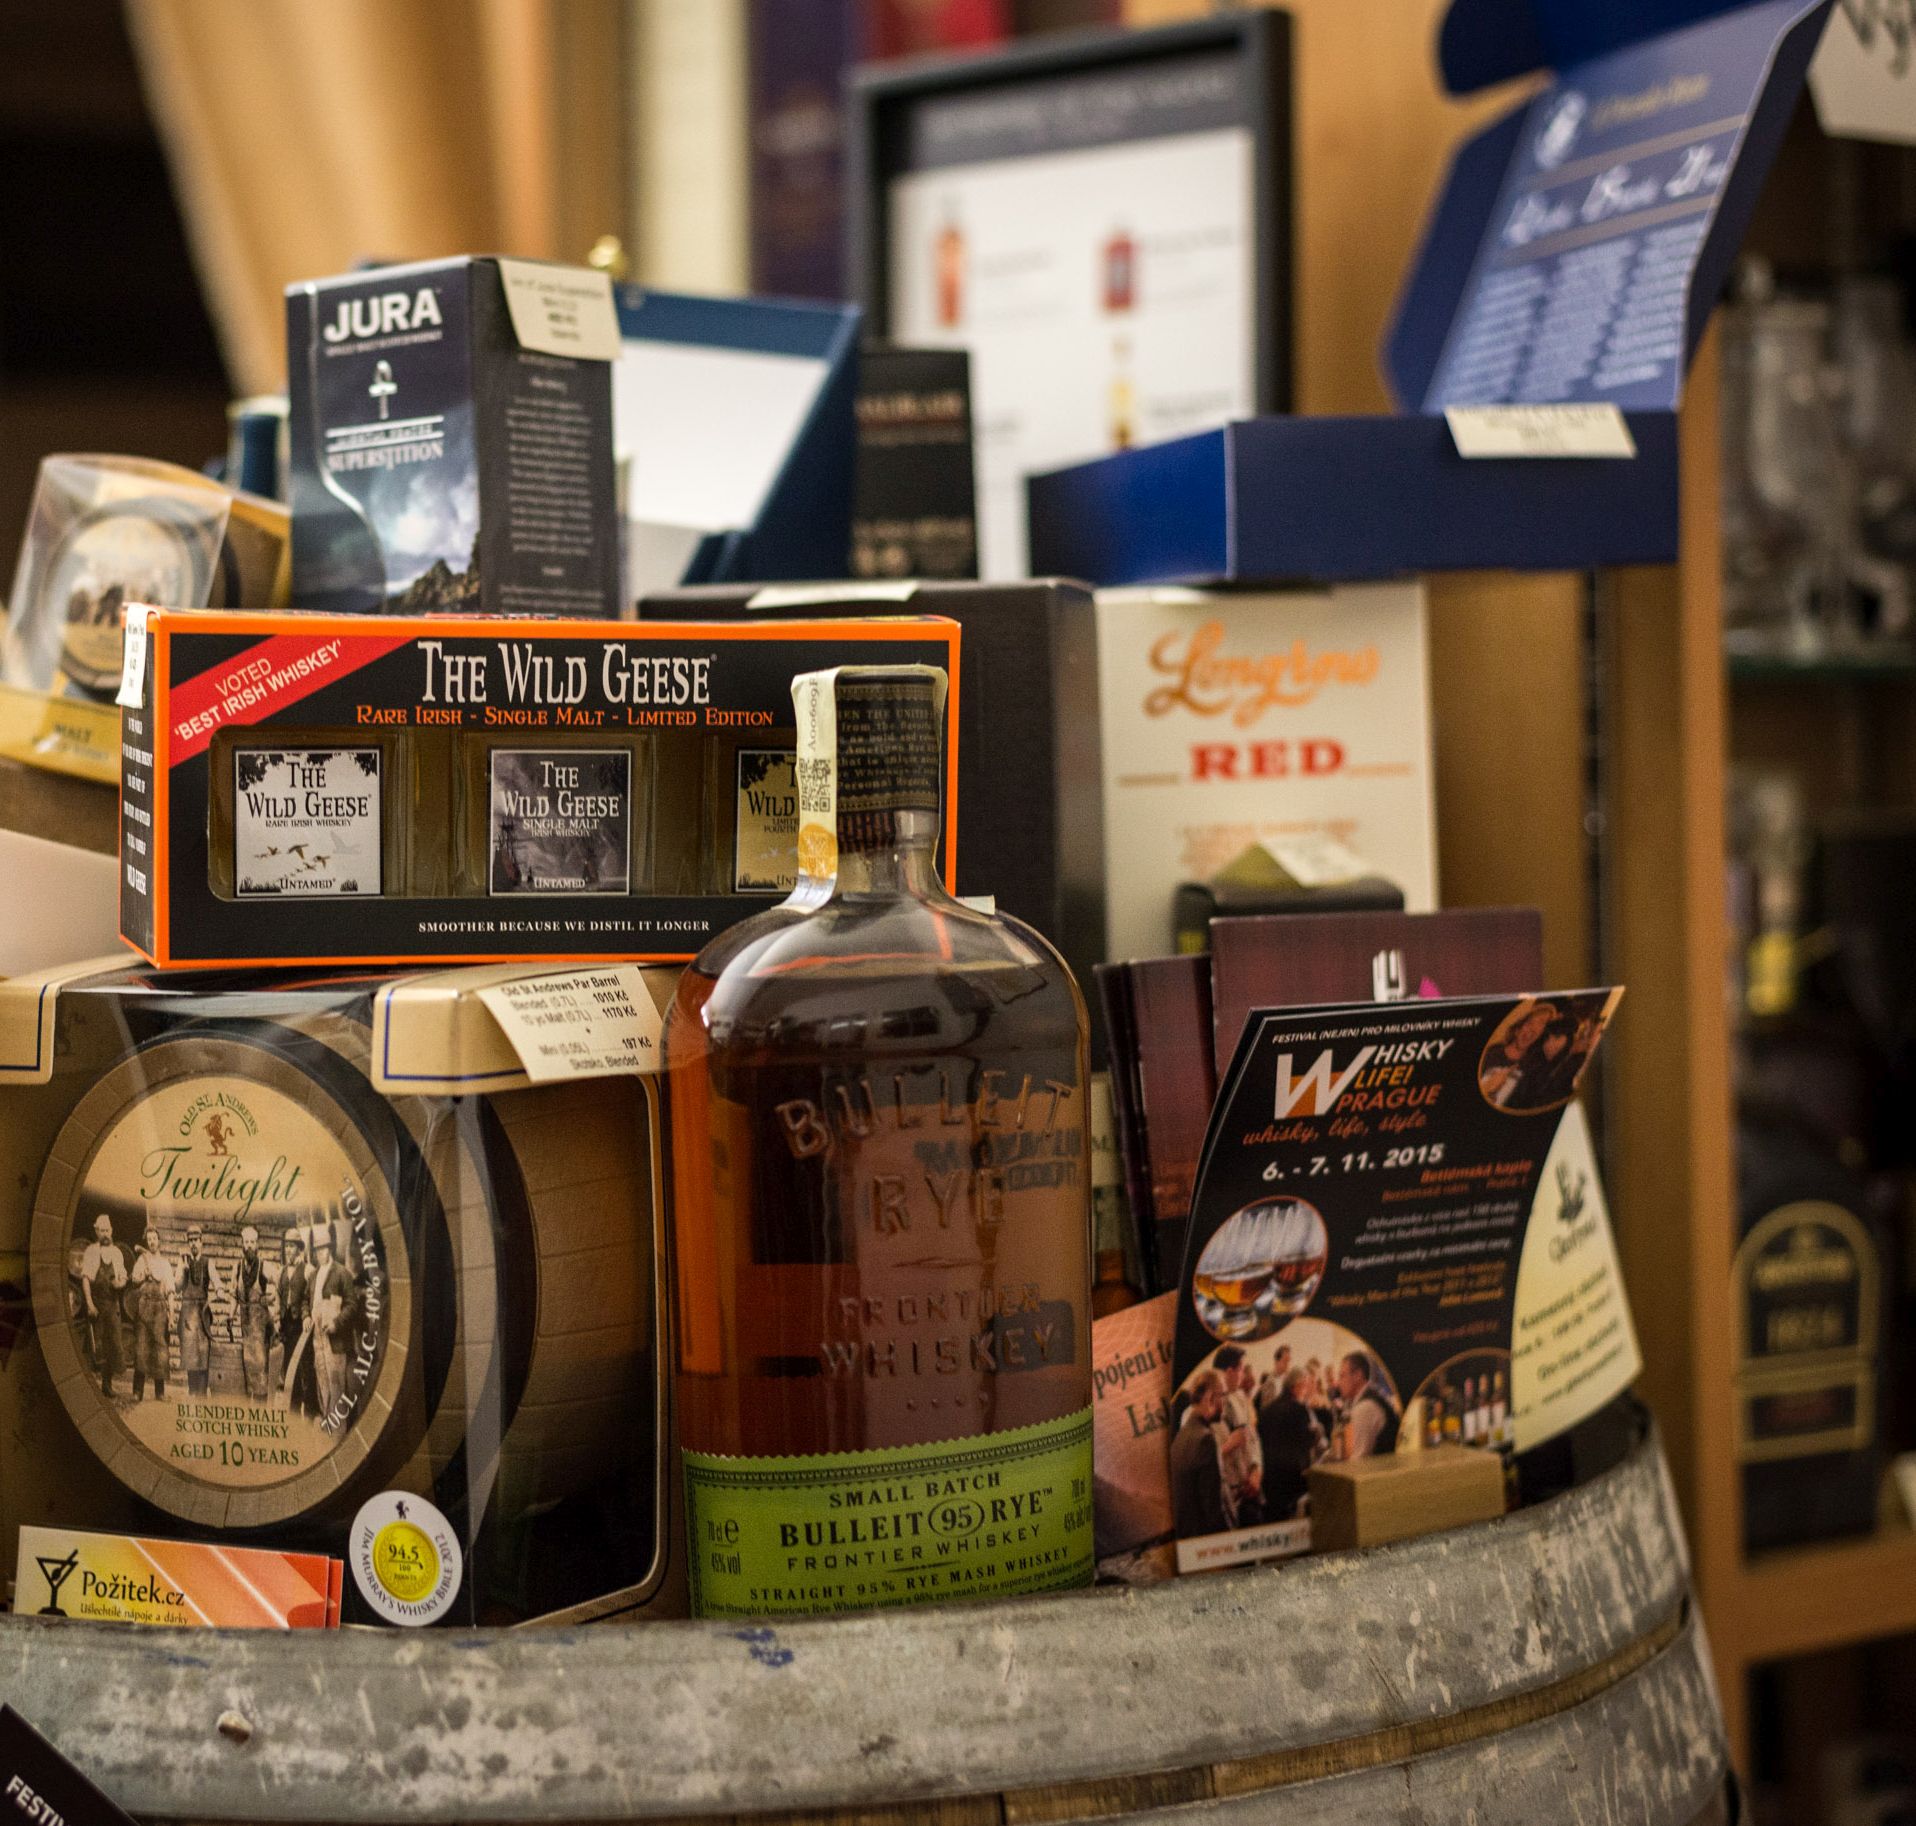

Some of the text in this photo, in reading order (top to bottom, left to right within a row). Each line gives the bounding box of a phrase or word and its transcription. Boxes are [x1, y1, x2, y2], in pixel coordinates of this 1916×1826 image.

[324, 288, 442, 342] JURA
[215, 658, 272, 697] VOTED
[418, 641, 710, 705] THE WILD GEESE
[224, 684, 269, 718] IRISH
[357, 705, 407, 725] RARE
[416, 706, 462, 725] IRISH
[485, 707, 548, 725] SINGLE
[555, 707, 605, 726] MALT
[627, 707, 697, 726] LIMITED
[705, 708, 774, 726] EDITION
[1191, 736, 1345, 781] RED
[286, 761, 327, 789] THE
[540, 760, 579, 788] THE
[246, 791, 369, 819] WILD GEESE
[502, 790, 620, 818] WILD GEESE
[747, 791, 796, 817] WILD
[265, 818, 352, 828] RARE IRISH WHISKEY
[523, 818, 600, 830] SINGLE MALT
[279, 878, 332, 890] UNTAMED
[533, 877, 586, 889] UNTAMED
[418, 920, 711, 933] SMOOTHER BECAUSE WE DISTIL IT LONGER
[533, 979, 574, 995] Andrews
[575, 979, 590, 991] Par
[592, 974, 621, 988] Barrel
[592, 991, 614, 1004] 1010
[615, 990, 630, 1002] Kč
[602, 1007, 623, 1019] 1170
[623, 1005, 638, 1018] Kč
[622, 1037, 637, 1049] 197
[638, 1035, 652, 1048] Kč
[1272, 1031, 1318, 1044] FESTIVAL
[1361, 1025, 1383, 1036] PRO
[1441, 1017, 1481, 1029] WHISKY
[605, 1054, 640, 1069] Blended
[1353, 1064, 1415, 1089] LIFE!
[1335, 1083, 1442, 1114] PRAGUE
[179, 1105, 198, 1137] OLD
[215, 1091, 259, 1136] ANDREWS
[774, 1070, 1077, 1160] BULLEIT
[1378, 1109, 1428, 1133] style
[1262, 1160, 1284, 1182] 6.
[1309, 1156, 1330, 1176] 7.
[1341, 1152, 1375, 1173] 11.
[1383, 1142, 1446, 1169] 2015
[140, 1146, 304, 1225] Twilight
[872, 1168, 1005, 1235] RYE
[360, 1238, 379, 1271] BY
[365, 1275, 381, 1322] 40%
[353, 1330, 379, 1385] ALC.
[820, 1321, 1055, 1378] WHISKEY
[177, 1403, 288, 1423] BLENDED MALT
[321, 1393, 358, 1436] 70CL
[175, 1419, 290, 1439] SCOTCH WHISKY
[170, 1440, 300, 1467] AGED 10 YEARS
[829, 1471, 1001, 1509] SMALL BATCH
[361, 1526, 375, 1550] JIM
[780, 1511, 924, 1548] BULLEIT
[941, 1504, 974, 1532] 95
[388, 1543, 419, 1561] 94.5
[787, 1524, 1041, 1571] FRONTIER WHISKEY
[361, 1552, 395, 1609] MURRAY'S
[436, 1567, 454, 1600] BIBLE
[751, 1545, 1069, 1601] STRAIGHT 95% RYE MASH WHISKEY
[81, 1570, 186, 1607] Požitek.cz
[763, 1605, 809, 1616] American
[978, 1583, 991, 1593] for
[80, 1601, 188, 1625] Ušlechtilé nápoje a dárky
[397, 1597, 439, 1616] WHISKY
